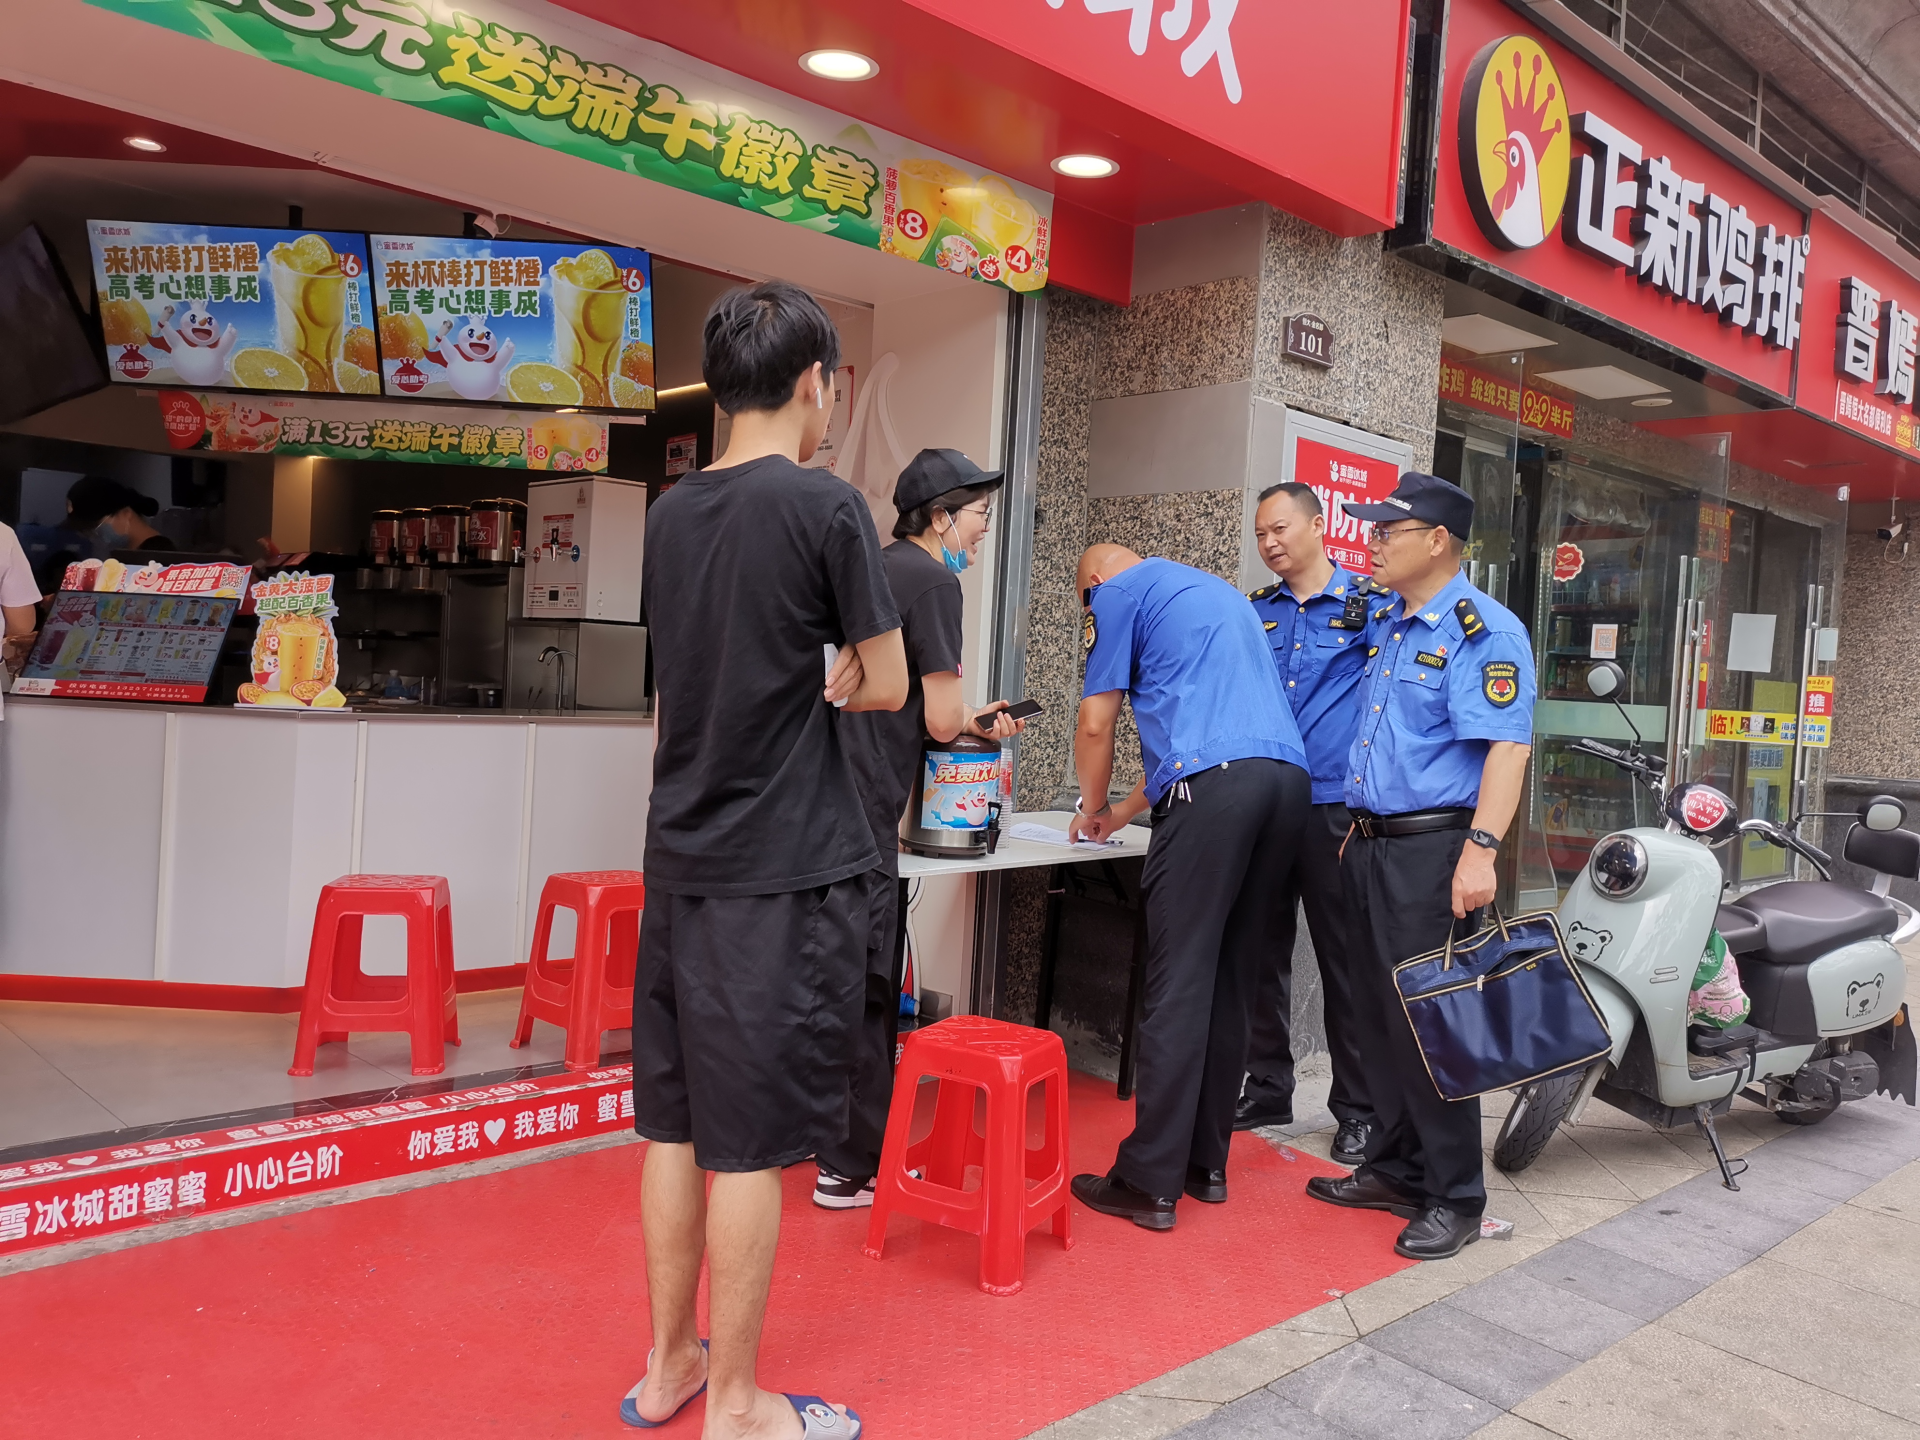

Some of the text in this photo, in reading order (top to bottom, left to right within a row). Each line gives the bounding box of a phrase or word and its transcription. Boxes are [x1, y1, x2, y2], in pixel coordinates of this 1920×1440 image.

[883, 167, 899, 228] 菠萝百香果
[904, 211, 923, 240] 8
[1577, 110, 1806, 350] 正新鸡排
[1034, 215, 1050, 272] 冰鲜柠檬水
[103, 244, 260, 274] 来杯棒打鲜橙
[345, 256, 359, 276] 6
[1012, 249, 1028, 272] 4
[385, 258, 542, 289] 来杯棒打鲜橙
[628, 269, 641, 290] 6
[108, 274, 261, 302] 高考心想事成
[388, 288, 540, 316] 高考心想事成
[347, 281, 362, 324] 棒打鲜橙
[628, 296, 640, 339] 棒打鲜橙
[1300, 332, 1322, 357] 101
[1470, 376, 1520, 413] 统统只要
[1551, 405, 1573, 431] 半斤
[281, 416, 524, 457] 满13元送端午徽章
[536, 446, 546, 458] 8
[587, 448, 598, 461] 4
[1340, 464, 1368, 482] 蜜雪冰城
[165, 565, 223, 581] 果茶加冰
[253, 576, 332, 598] 金黄大菠萝
[256, 592, 331, 612] 超配百香果
[269, 635, 279, 650] 8
[1808, 693, 1825, 708] 推
[439, 1080, 541, 1106] 小心台阶
[226, 1099, 432, 1142] 蜜雪冰城甜蜜蜜
[407, 1102, 580, 1162] 你爱我 我爱你
[110, 1137, 206, 1161] 我爱你
[0, 1143, 344, 1243] 雪冰城甜蜜蜜 小心台阶
